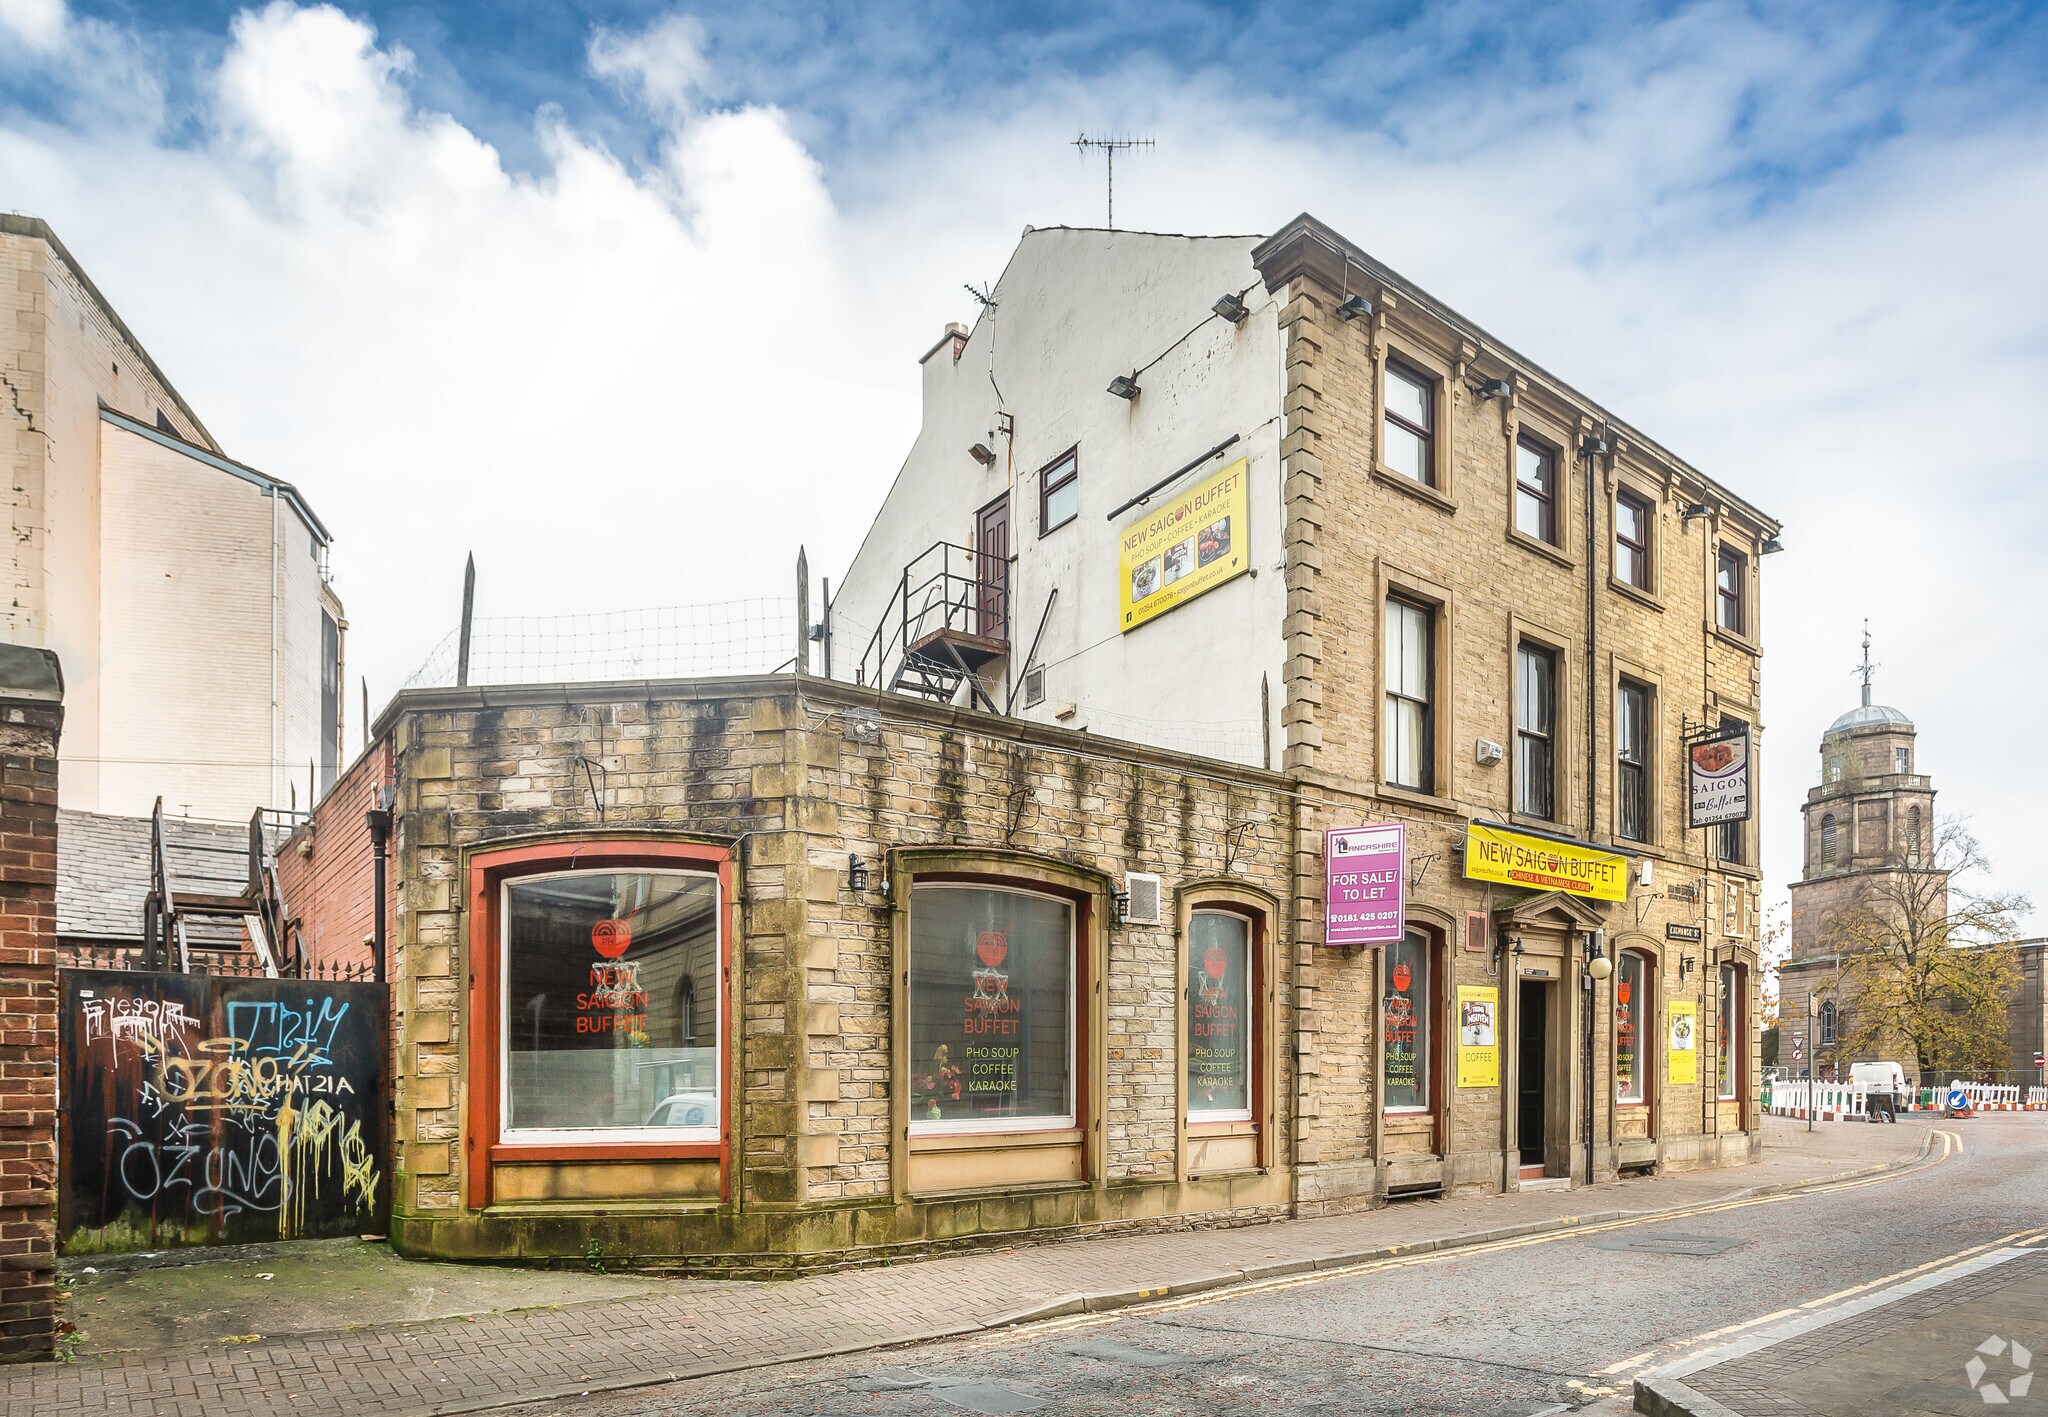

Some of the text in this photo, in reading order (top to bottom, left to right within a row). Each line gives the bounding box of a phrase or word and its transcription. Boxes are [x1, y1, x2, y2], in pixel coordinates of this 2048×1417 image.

[1124, 528, 1148, 553] NEW
[1195, 473, 1240, 511] BUFFET
[1131, 498, 1232, 563] PHO SOUP COFFEE KARAOKE
[1138, 603, 1153, 615] 01254
[1176, 567, 1224, 597] saigonbuffet.co.uk
[1693, 777, 1746, 794] SAIGON
[1706, 794, 1732, 811] Buffet
[1725, 811, 1747, 819] 670078
[1480, 840, 1616, 883] NEW SAIGON BUFFET
[1332, 871, 1397, 886] FOR SALE/
[1512, 870, 1534, 882] CHINESE
[1540, 876, 1571, 889] VIETNAMESE
[1572, 882, 1591, 892] CUISINE
[1343, 887, 1385, 900] TO LET
[1338, 911, 1398, 922] 0161 425 0207
[590, 968, 633, 986] NEW
[975, 976, 1009, 992] NEW
[576, 991, 649, 1010] SAIGON
[964, 997, 1020, 1014] SAIGON
[1391, 999, 1412, 1010] NEW
[1195, 1005, 1237, 1018] SAIGON
[576, 1014, 648, 1033] BUFFET
[964, 1018, 1020, 1034] BUFFET
[1385, 1014, 1418, 1027] SAIGON
[1194, 1023, 1236, 1037] BUFFET
[1385, 1030, 1417, 1043] BUFFET
[1617, 1036, 1634, 1047] UFFET
[966, 1047, 1019, 1058] PHO SOUP
[1195, 1048, 1236, 1058] PHO SOUP
[1386, 1052, 1417, 1061] PHO SOUP
[1465, 1052, 1492, 1062] COFFEE
[972, 1063, 1013, 1075] COFFEE
[1200, 1063, 1231, 1072] COFFEE
[1389, 1065, 1413, 1074] COFFEE
[969, 1080, 1016, 1091] KARAOKE
[1197, 1077, 1233, 1086] KARAOKE
[1387, 1077, 1415, 1086] KARAOKE
